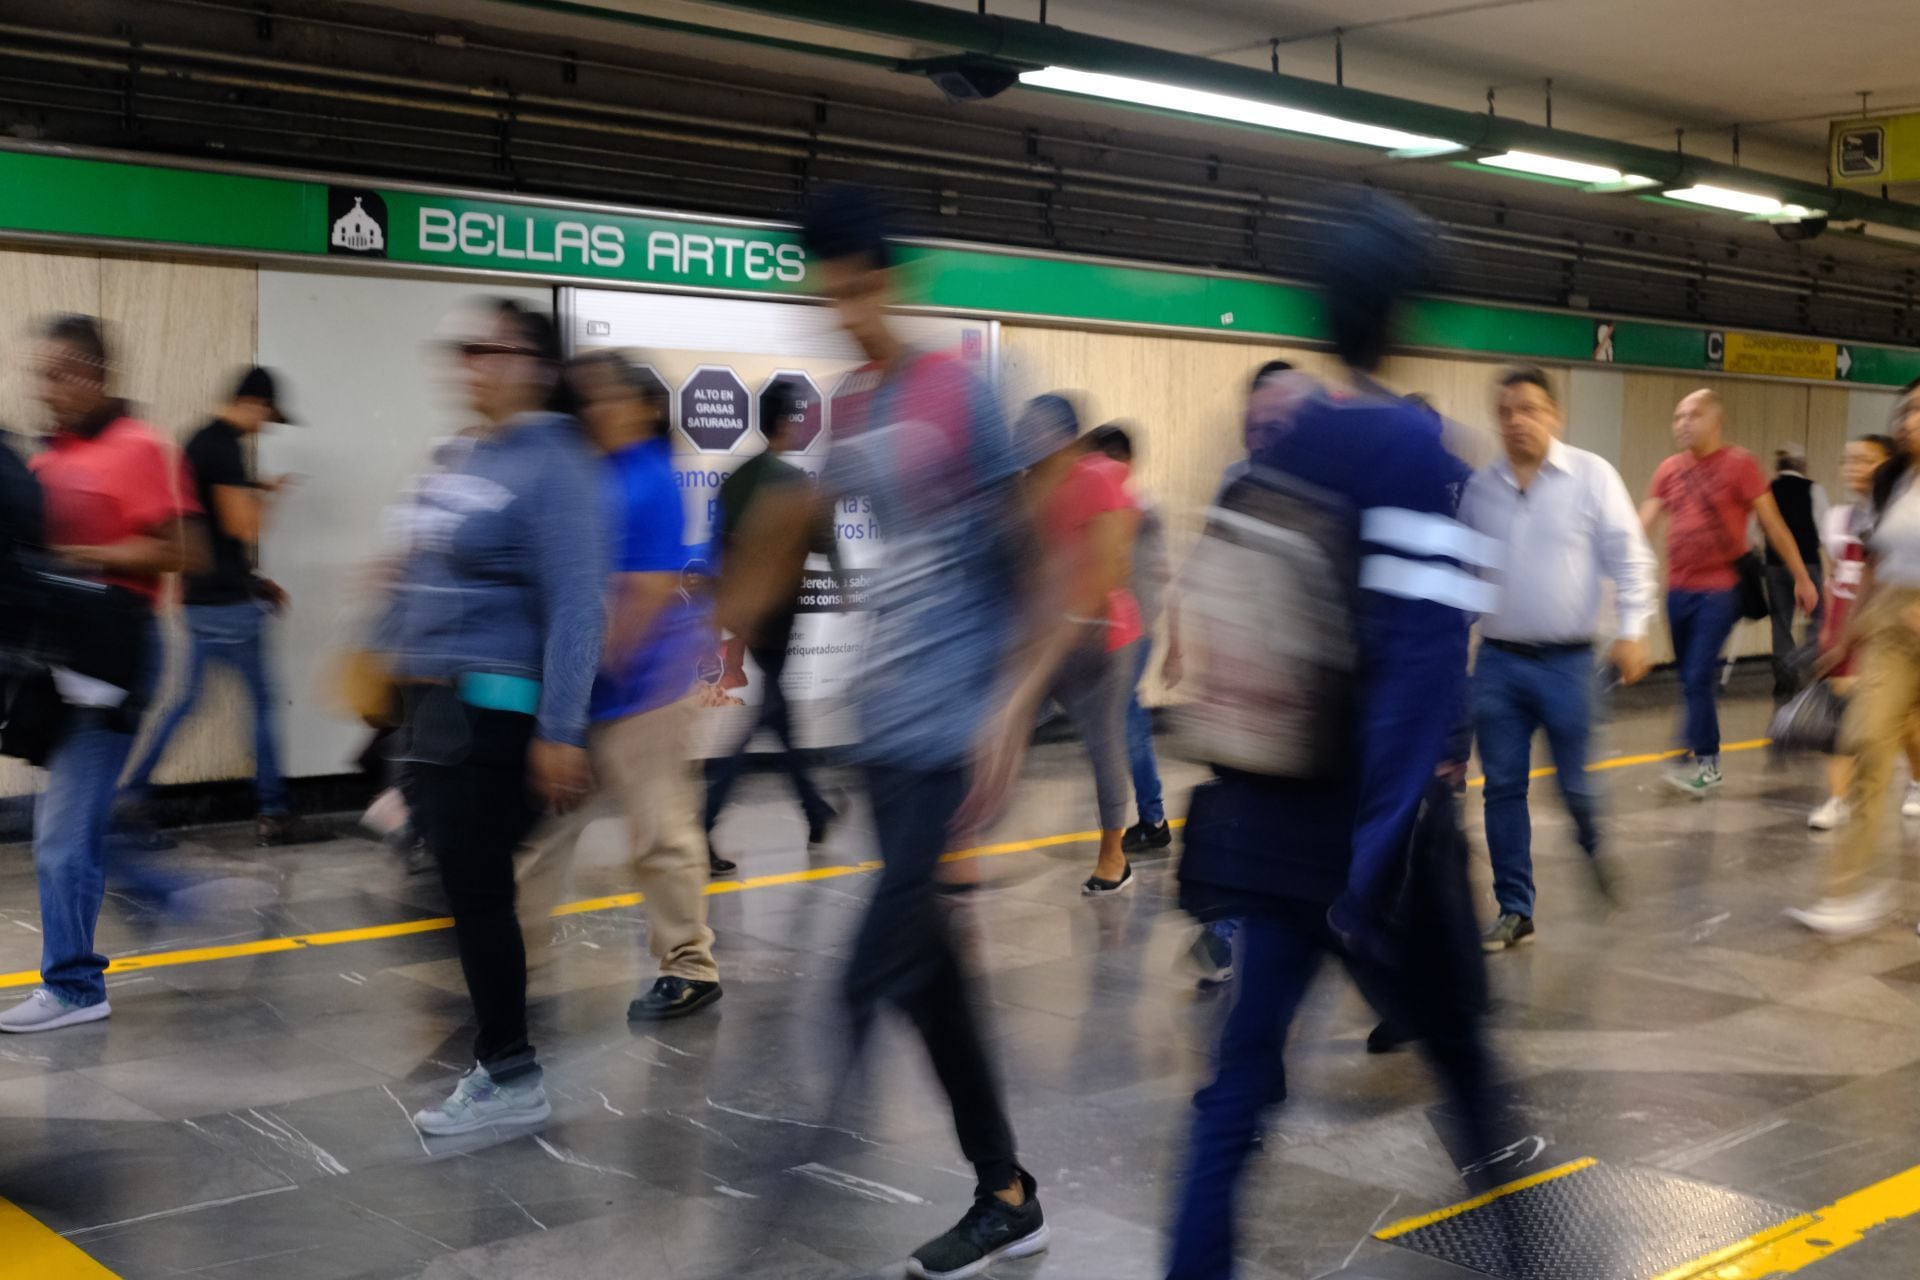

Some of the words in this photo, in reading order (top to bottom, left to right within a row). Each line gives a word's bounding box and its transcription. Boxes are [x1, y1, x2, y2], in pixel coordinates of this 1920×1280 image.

[418, 207, 626, 268] BELLAS
[647, 231, 806, 283] ARTES
[694, 389, 720, 401] ALTO
[720, 389, 734, 401] EN
[695, 403, 735, 415] GRASAS
[795, 399, 808, 409] EN
[687, 417, 743, 429] SATURADAS
[788, 413, 805, 423] DIO
[674, 470, 729, 488] amos
[837, 523, 864, 540] ros
